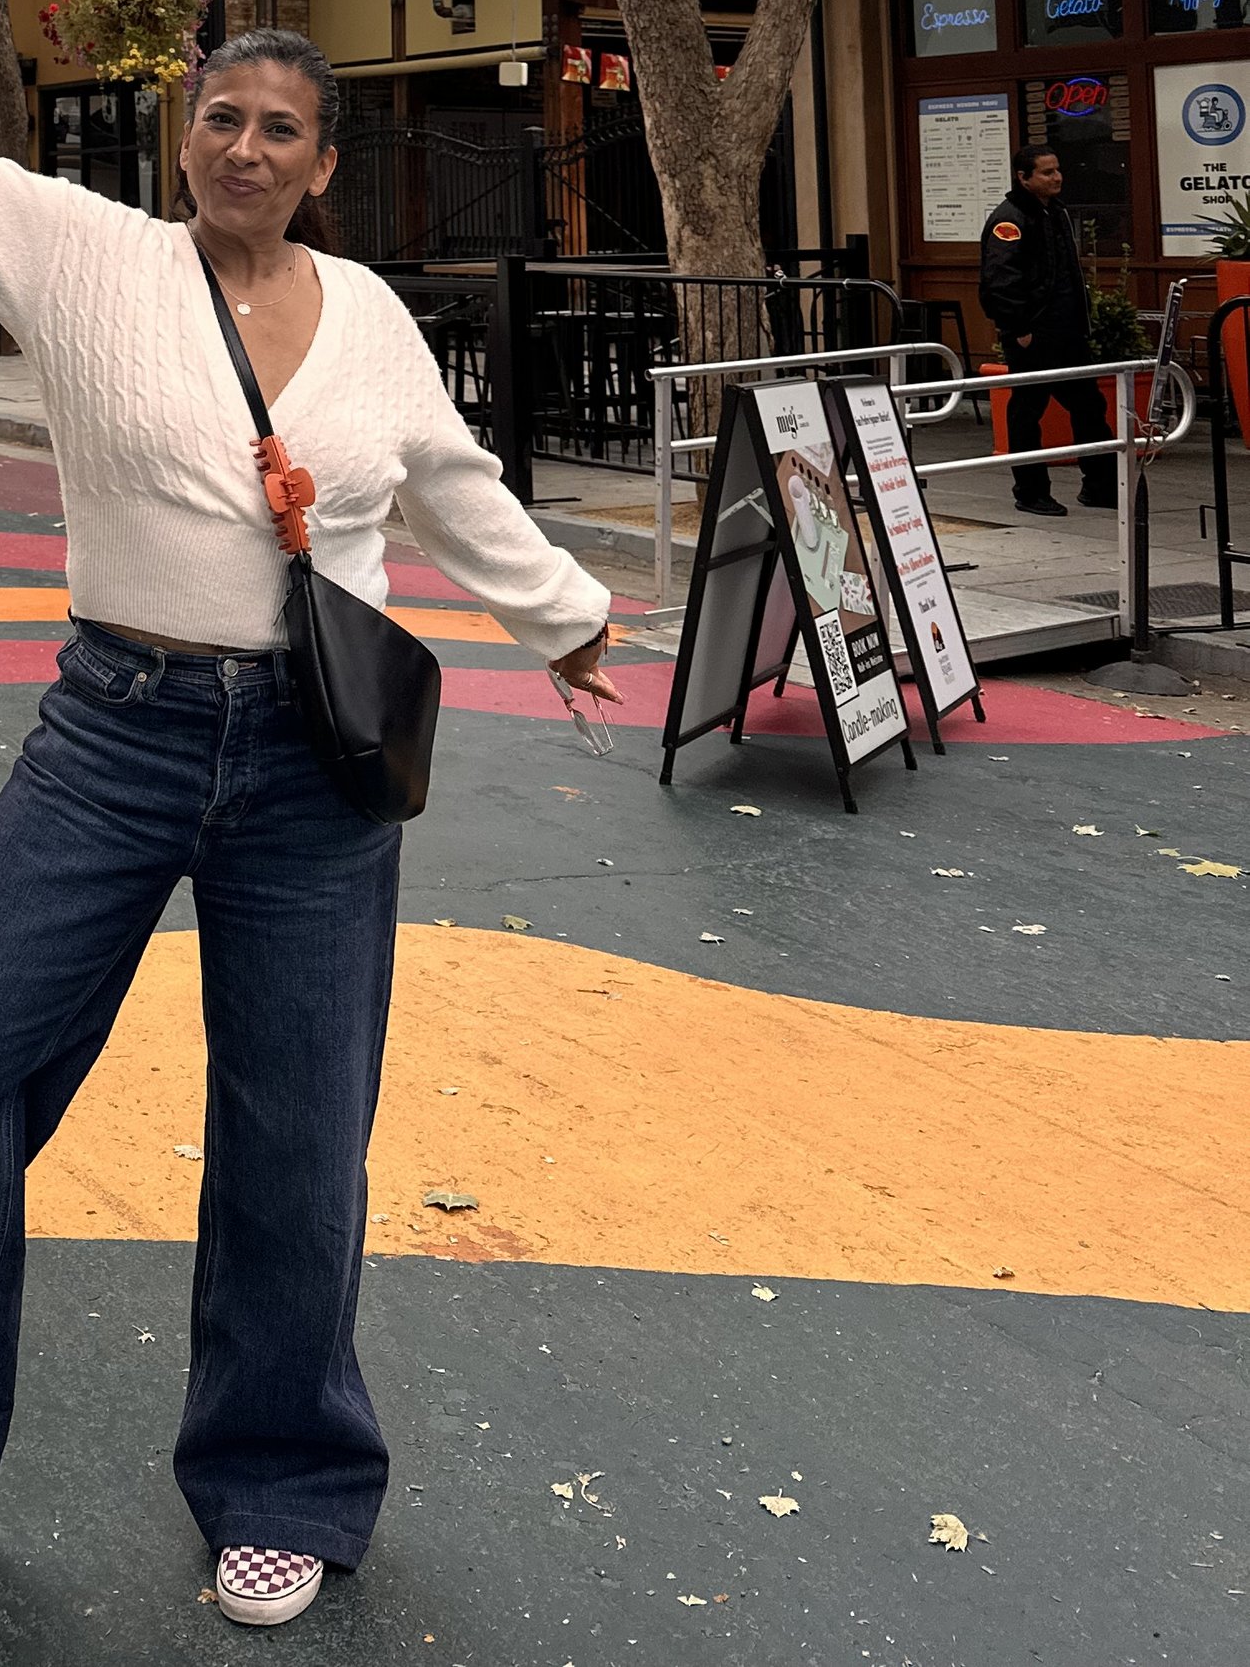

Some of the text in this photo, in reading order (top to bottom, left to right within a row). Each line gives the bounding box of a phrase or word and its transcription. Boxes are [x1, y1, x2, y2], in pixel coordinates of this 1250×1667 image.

[920, 2, 990, 33] Espresso
[1045, 82, 1109, 111] Open
[1203, 163, 1227, 172] THE
[1202, 195, 1233, 204] SHOP
[775, 405, 798, 439] migi
[851, 637, 868, 658] BOOK
[842, 697, 899, 744] Candle-making
